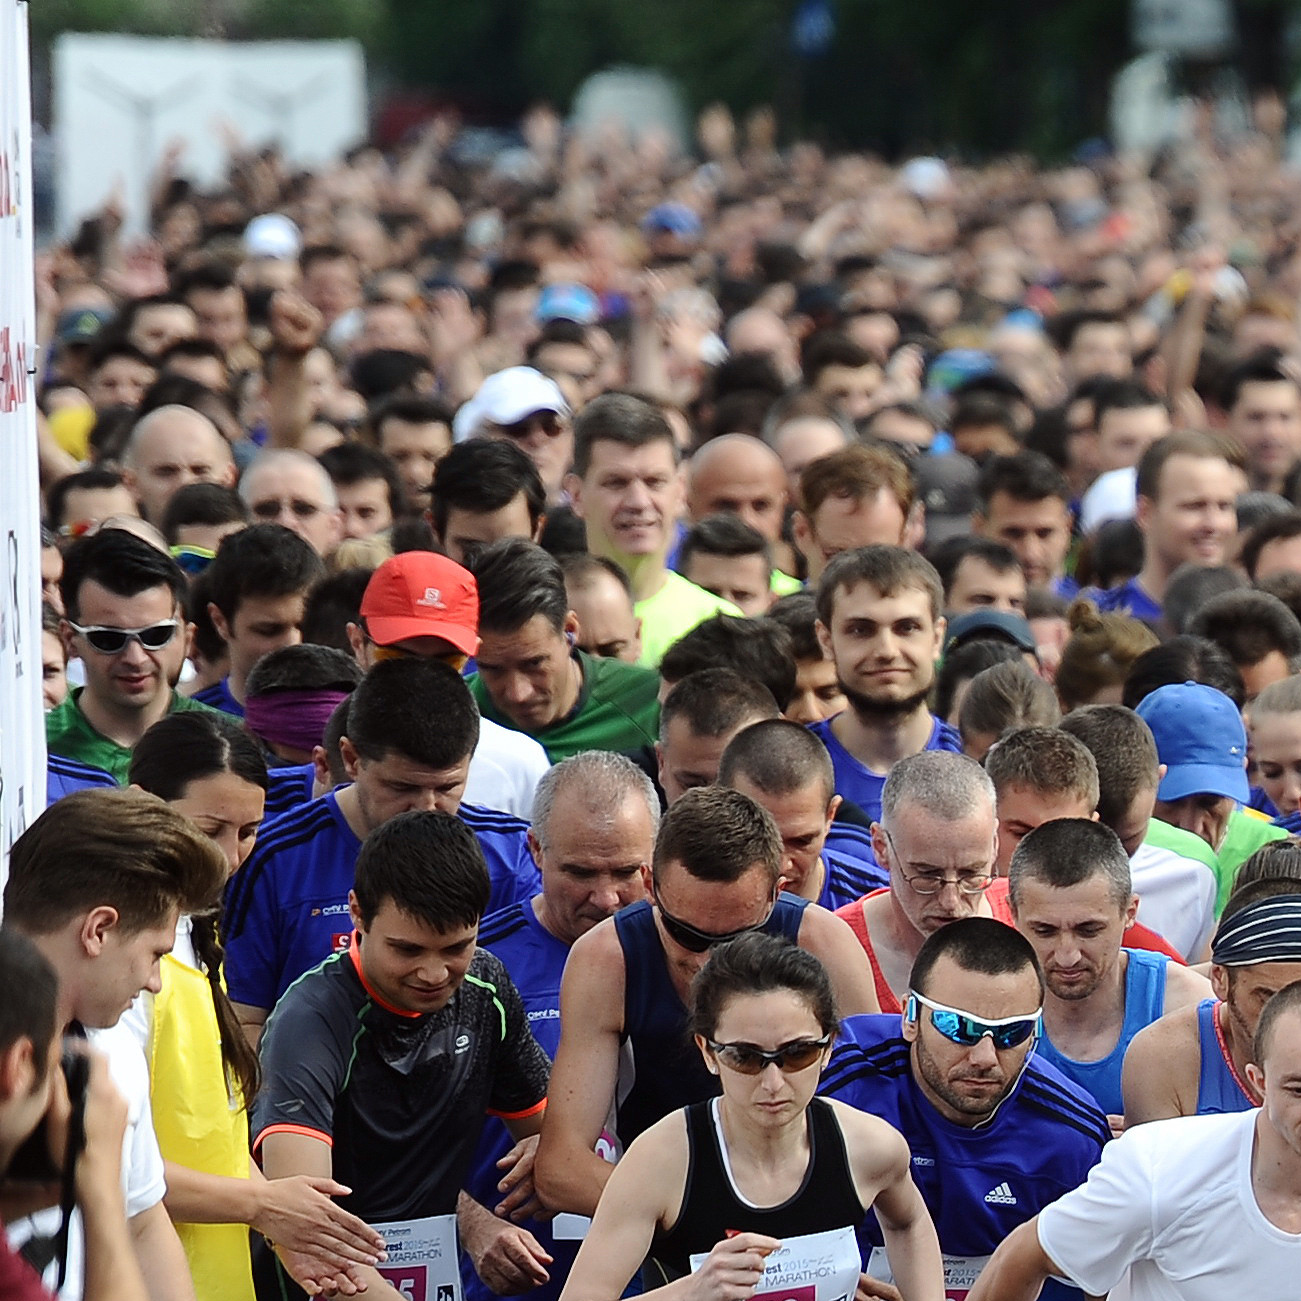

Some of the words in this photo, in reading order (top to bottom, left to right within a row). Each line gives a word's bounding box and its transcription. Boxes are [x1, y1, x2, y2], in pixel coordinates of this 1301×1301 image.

[984, 1195, 1017, 1205] adidas
[388, 1227, 411, 1237] Petrom
[387, 1248, 442, 1263] MARATHON
[783, 1258, 809, 1273] 2015
[942, 1258, 966, 1266] etrom
[765, 1265, 837, 1288] MARATHON
